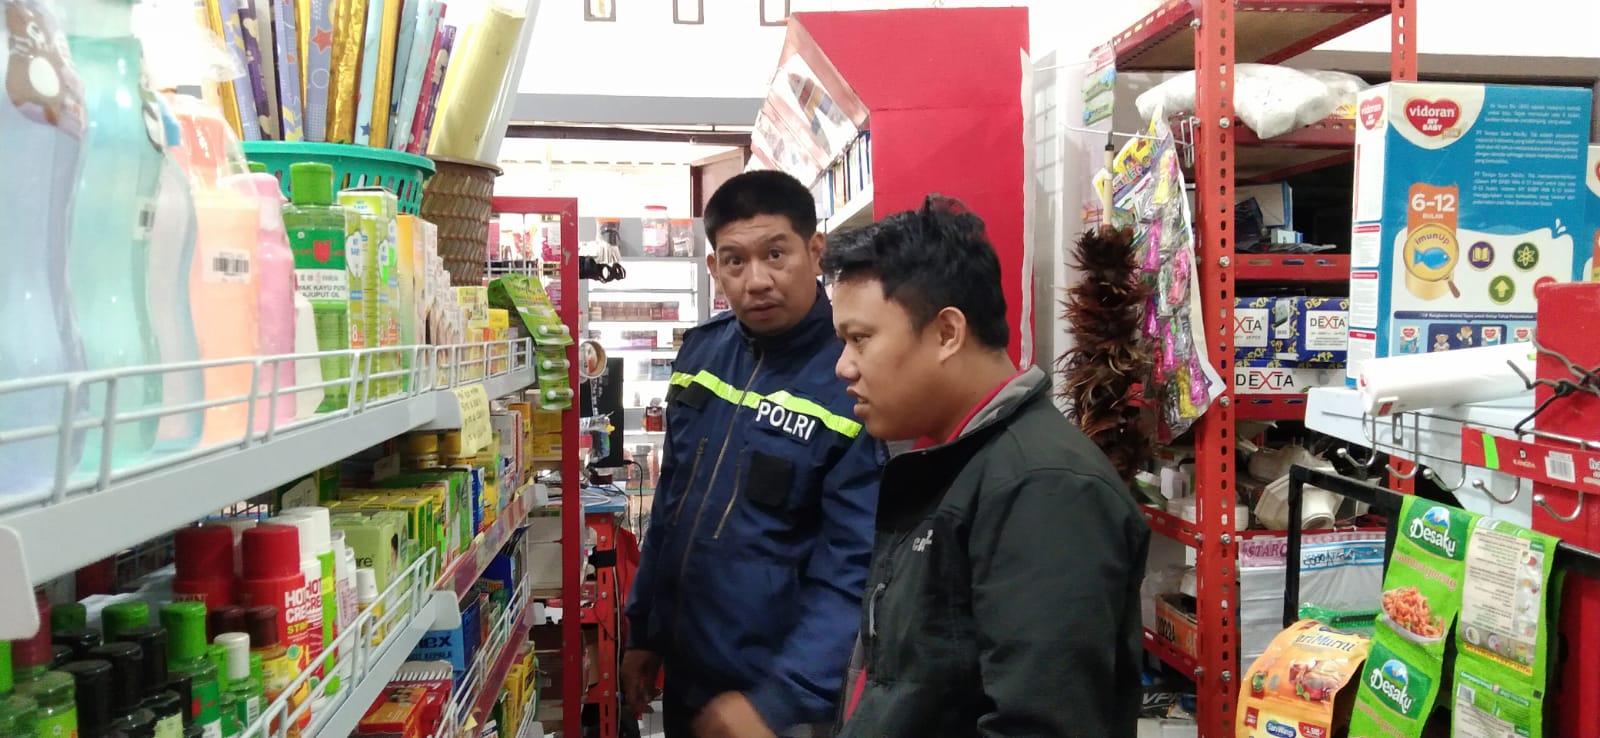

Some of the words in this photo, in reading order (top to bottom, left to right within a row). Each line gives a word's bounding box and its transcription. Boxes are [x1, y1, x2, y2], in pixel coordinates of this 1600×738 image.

[1409, 105, 1455, 118] vidoran
[1411, 193, 1455, 212] 6-12
[1310, 316, 1346, 329] DEXTA
[1235, 371, 1294, 390] DEXTA
[755, 401, 816, 440] POLRI
[1410, 518, 1456, 557] Desaku
[284, 587, 306, 608] HO
[1370, 668, 1413, 714] Desaku
